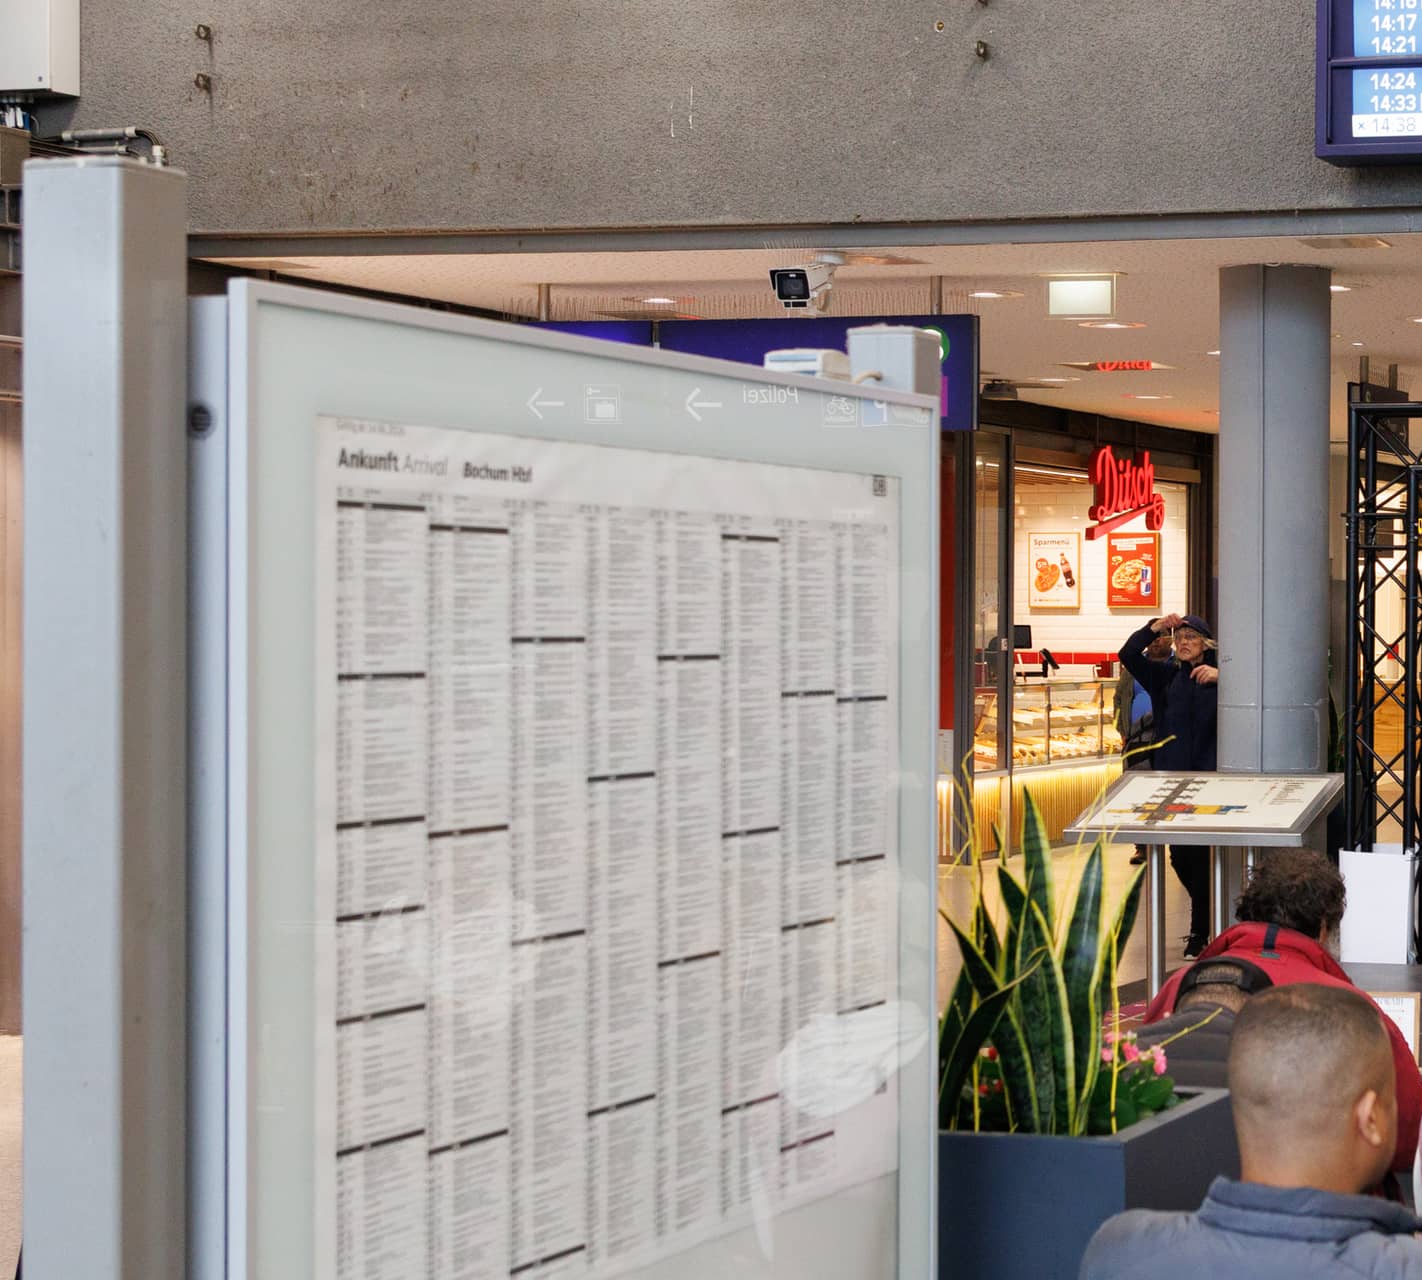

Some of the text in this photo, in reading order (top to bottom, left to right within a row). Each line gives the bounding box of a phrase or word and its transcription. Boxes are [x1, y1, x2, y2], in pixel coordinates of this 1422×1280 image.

[1371, 14, 1417, 32] 14:17
[1371, 36, 1416, 53] 14:21
[1370, 73, 1416, 90] 14:24
[1370, 94, 1416, 112] 14:33
[338, 448, 532, 483] Ankunft Arrival Bochum Hbf
[1096, 445, 1155, 521] Ditsch
